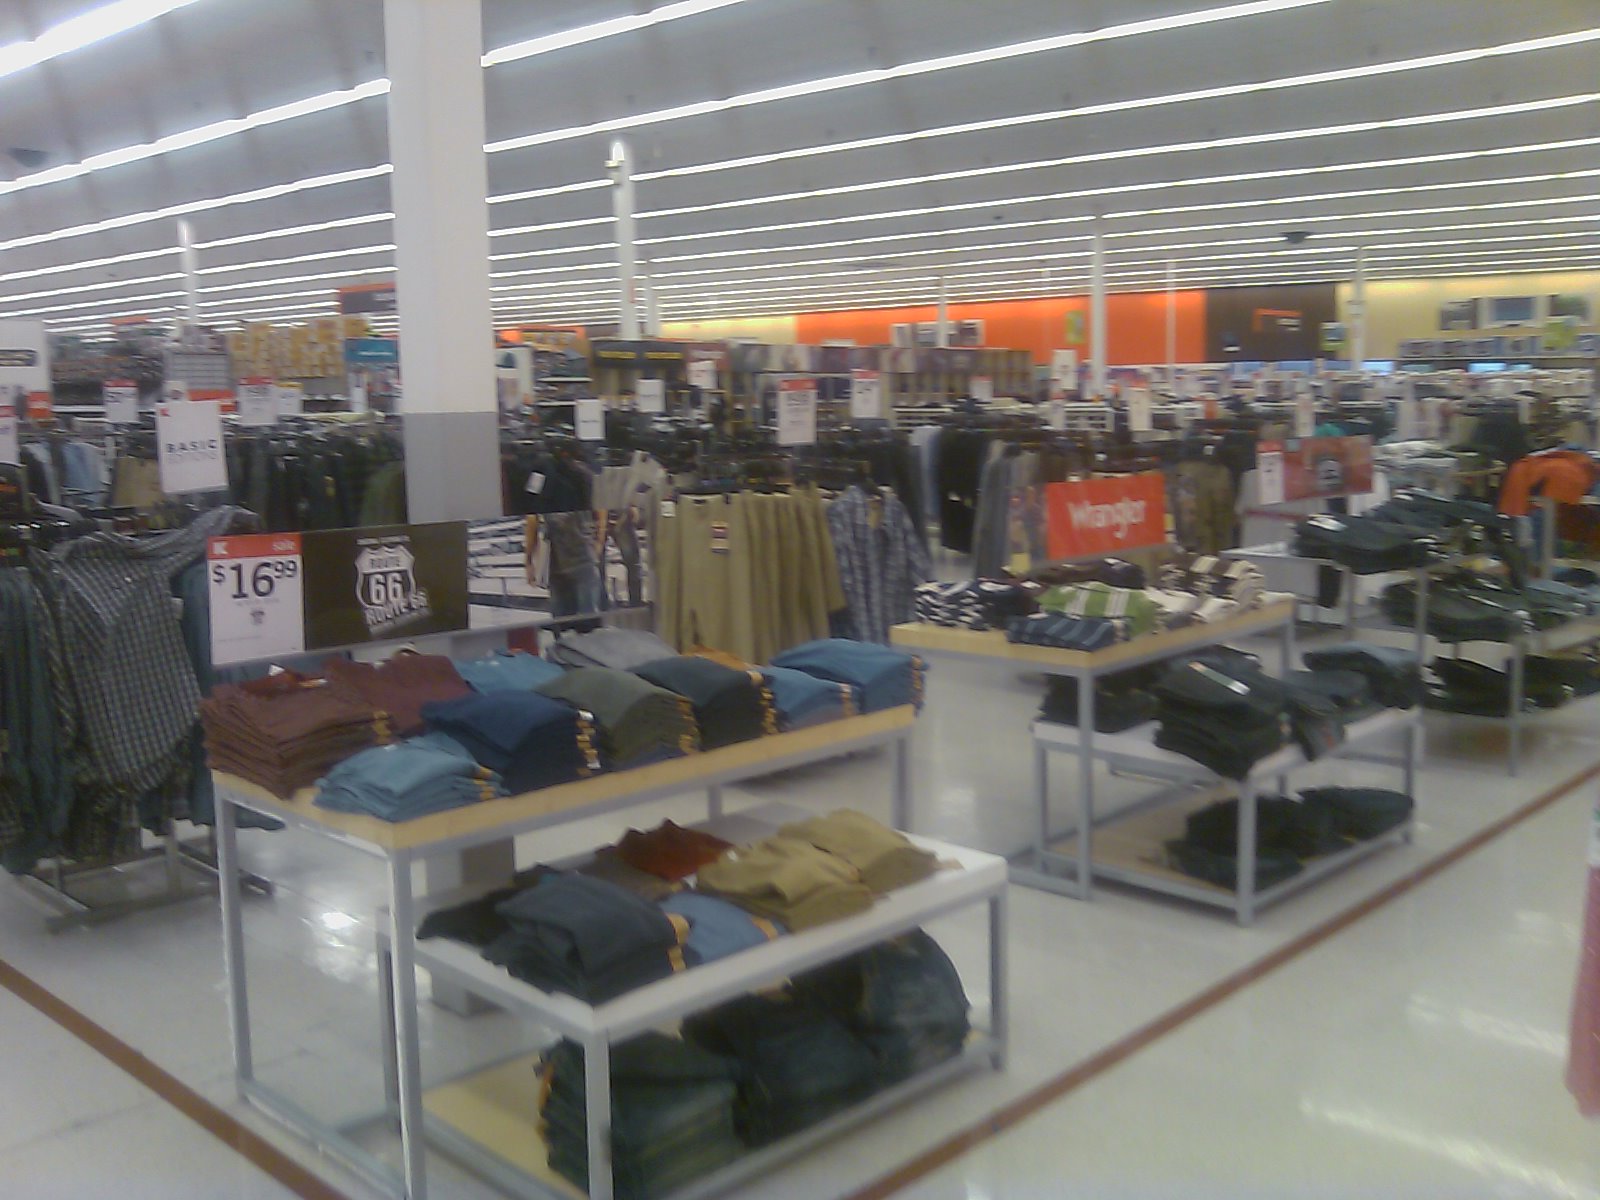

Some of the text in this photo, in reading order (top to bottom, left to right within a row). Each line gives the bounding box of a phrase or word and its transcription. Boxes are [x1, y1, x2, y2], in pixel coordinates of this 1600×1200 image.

[167, 439, 218, 454] BASIC
[1070, 497, 1146, 539] Wrangler
[368, 572, 403, 605] 66
